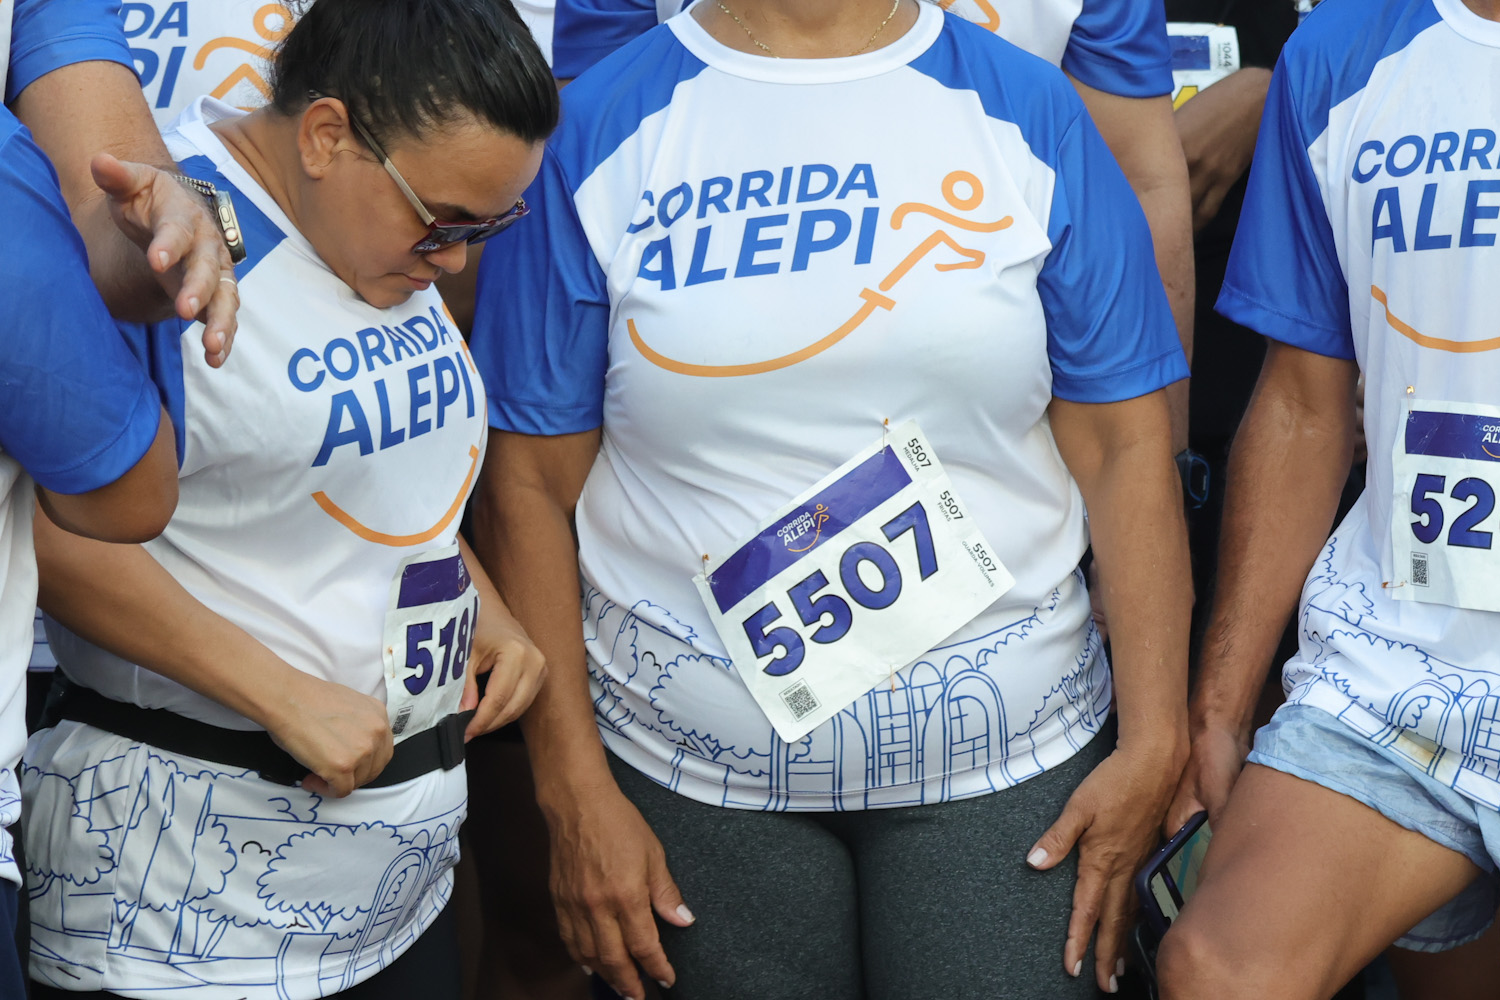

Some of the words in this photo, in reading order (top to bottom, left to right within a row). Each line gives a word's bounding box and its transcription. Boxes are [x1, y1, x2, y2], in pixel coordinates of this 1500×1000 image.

[627, 163, 879, 234] CORRIDA
[636, 206, 879, 291] ALEPI
[288, 306, 453, 392] CORRIDA
[311, 351, 475, 467] ALEPI
[903, 447, 920, 472] MEDALHA
[908, 438, 932, 468] 5507
[937, 502, 951, 522] FRUTAS
[940, 490, 964, 520] 5507
[777, 511, 811, 537] CORRIDA
[783, 517, 815, 546] ALEPI
[973, 543, 997, 573] 5507
[742, 500, 938, 676] 5507
